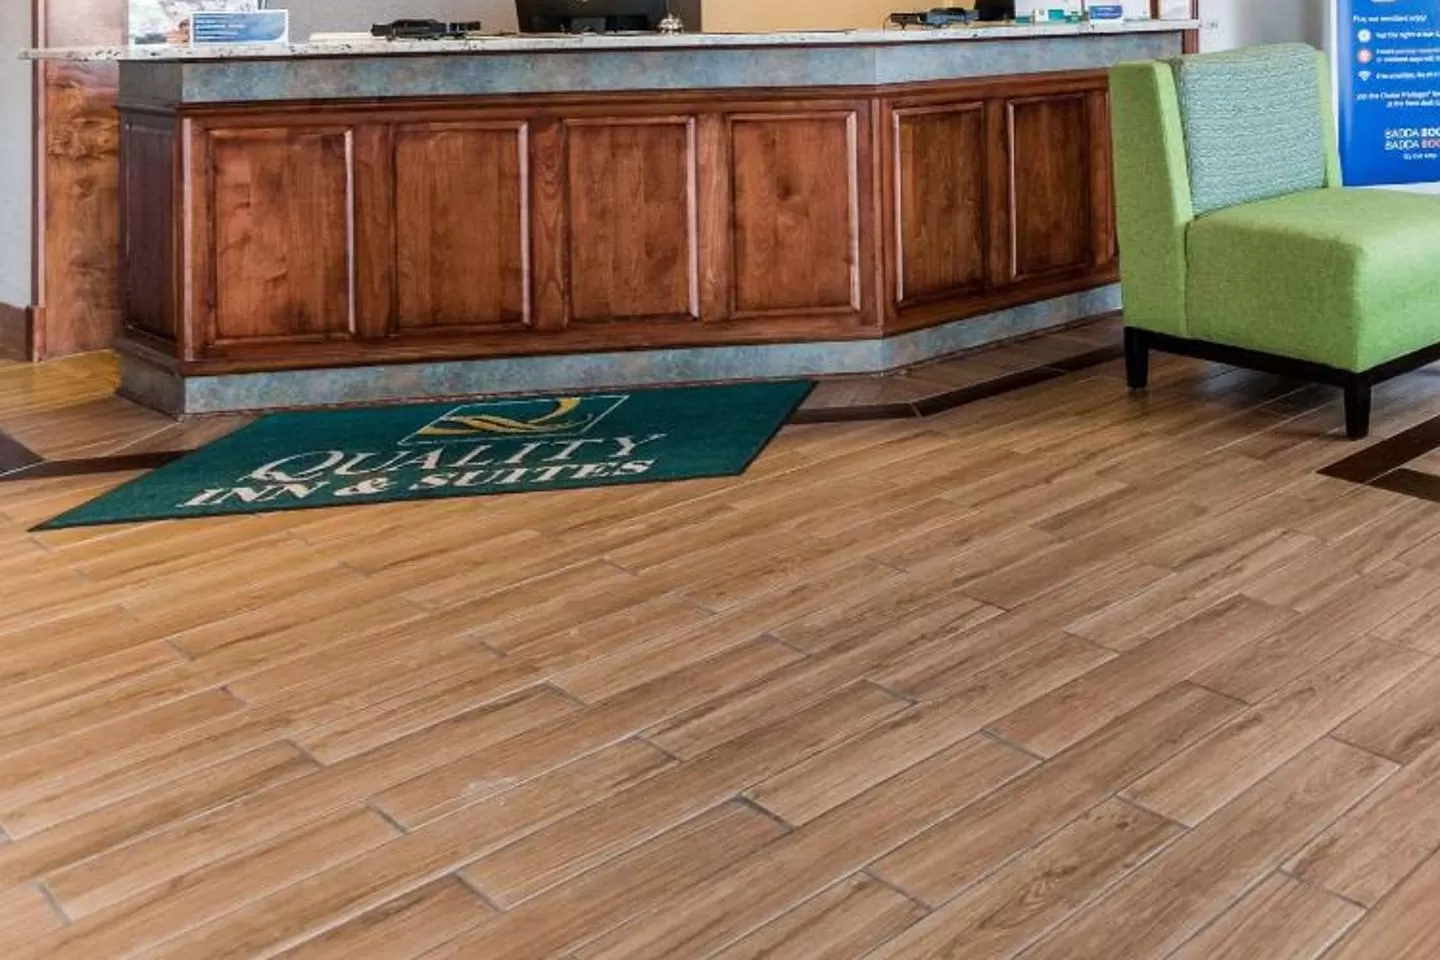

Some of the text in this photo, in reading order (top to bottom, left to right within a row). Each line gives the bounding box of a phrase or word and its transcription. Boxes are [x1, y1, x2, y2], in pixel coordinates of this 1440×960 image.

[174, 458, 657, 508] INN & SUITES
[236, 433, 668, 483] QUALITY
